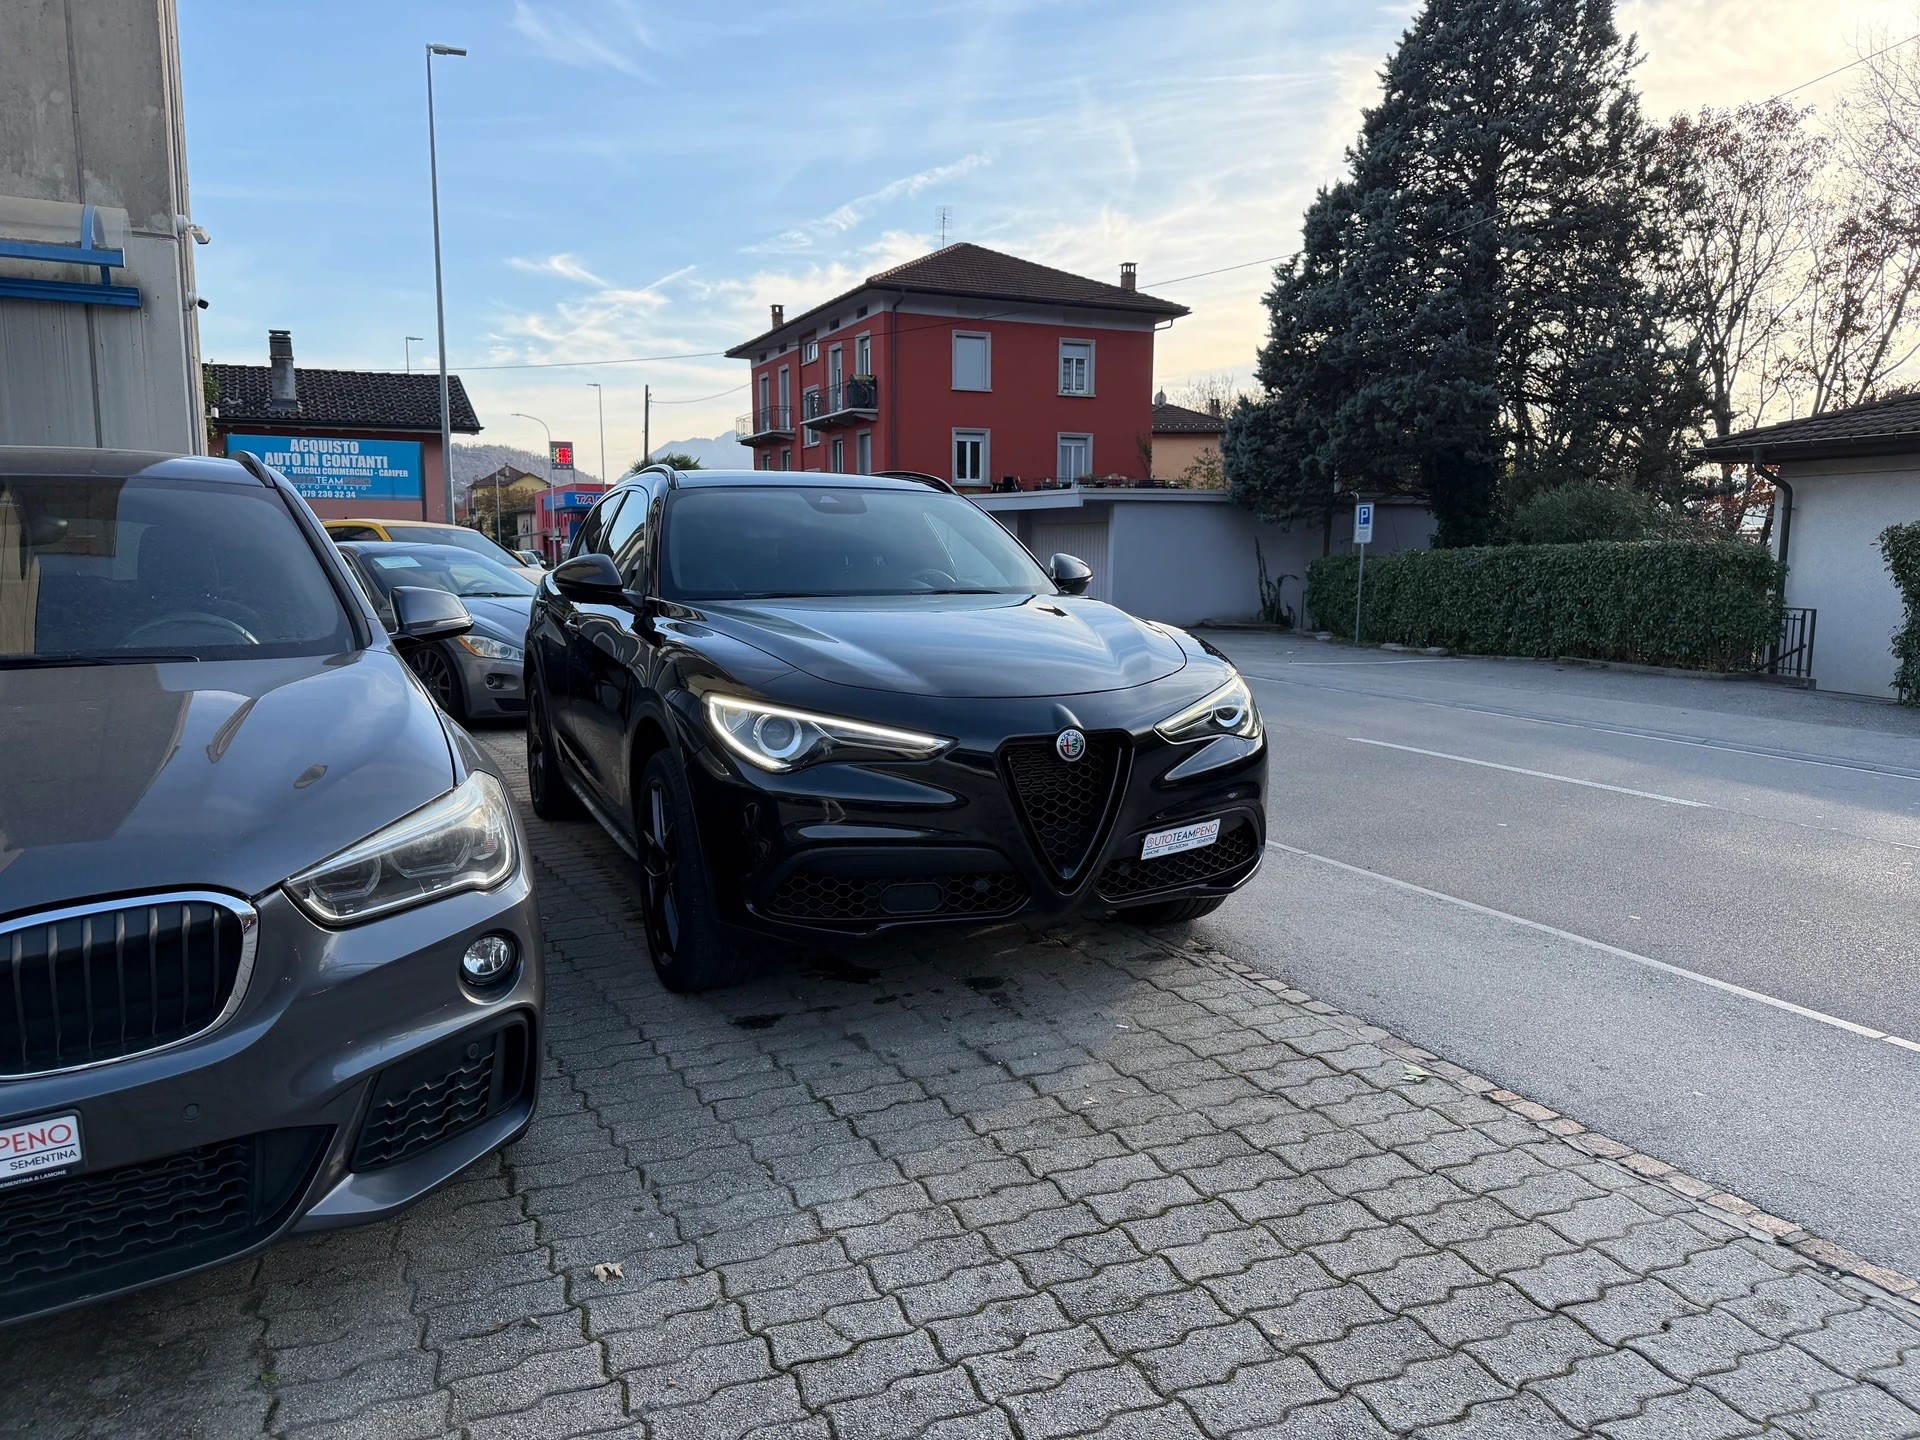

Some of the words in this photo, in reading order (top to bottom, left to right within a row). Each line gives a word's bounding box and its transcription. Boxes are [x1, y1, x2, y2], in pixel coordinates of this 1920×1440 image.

[290, 439, 359, 454] ACQUISTO
[264, 452, 301, 466] AUTO
[304, 453, 319, 467] IN
[322, 454, 388, 468] CONTANTI
[292, 466, 320, 475] VEICOLI
[322, 467, 373, 476] COMMERCIALI
[379, 469, 409, 478] CAMPER
[302, 490, 316, 498] 079
[317, 490, 333, 498] 230
[1361, 508, 1368, 523] P
[9, 1149, 77, 1171] SEMENTINA
[0, 1176, 33, 1188] EMENTINA
[40, 1169, 67, 1180] LAMONE
